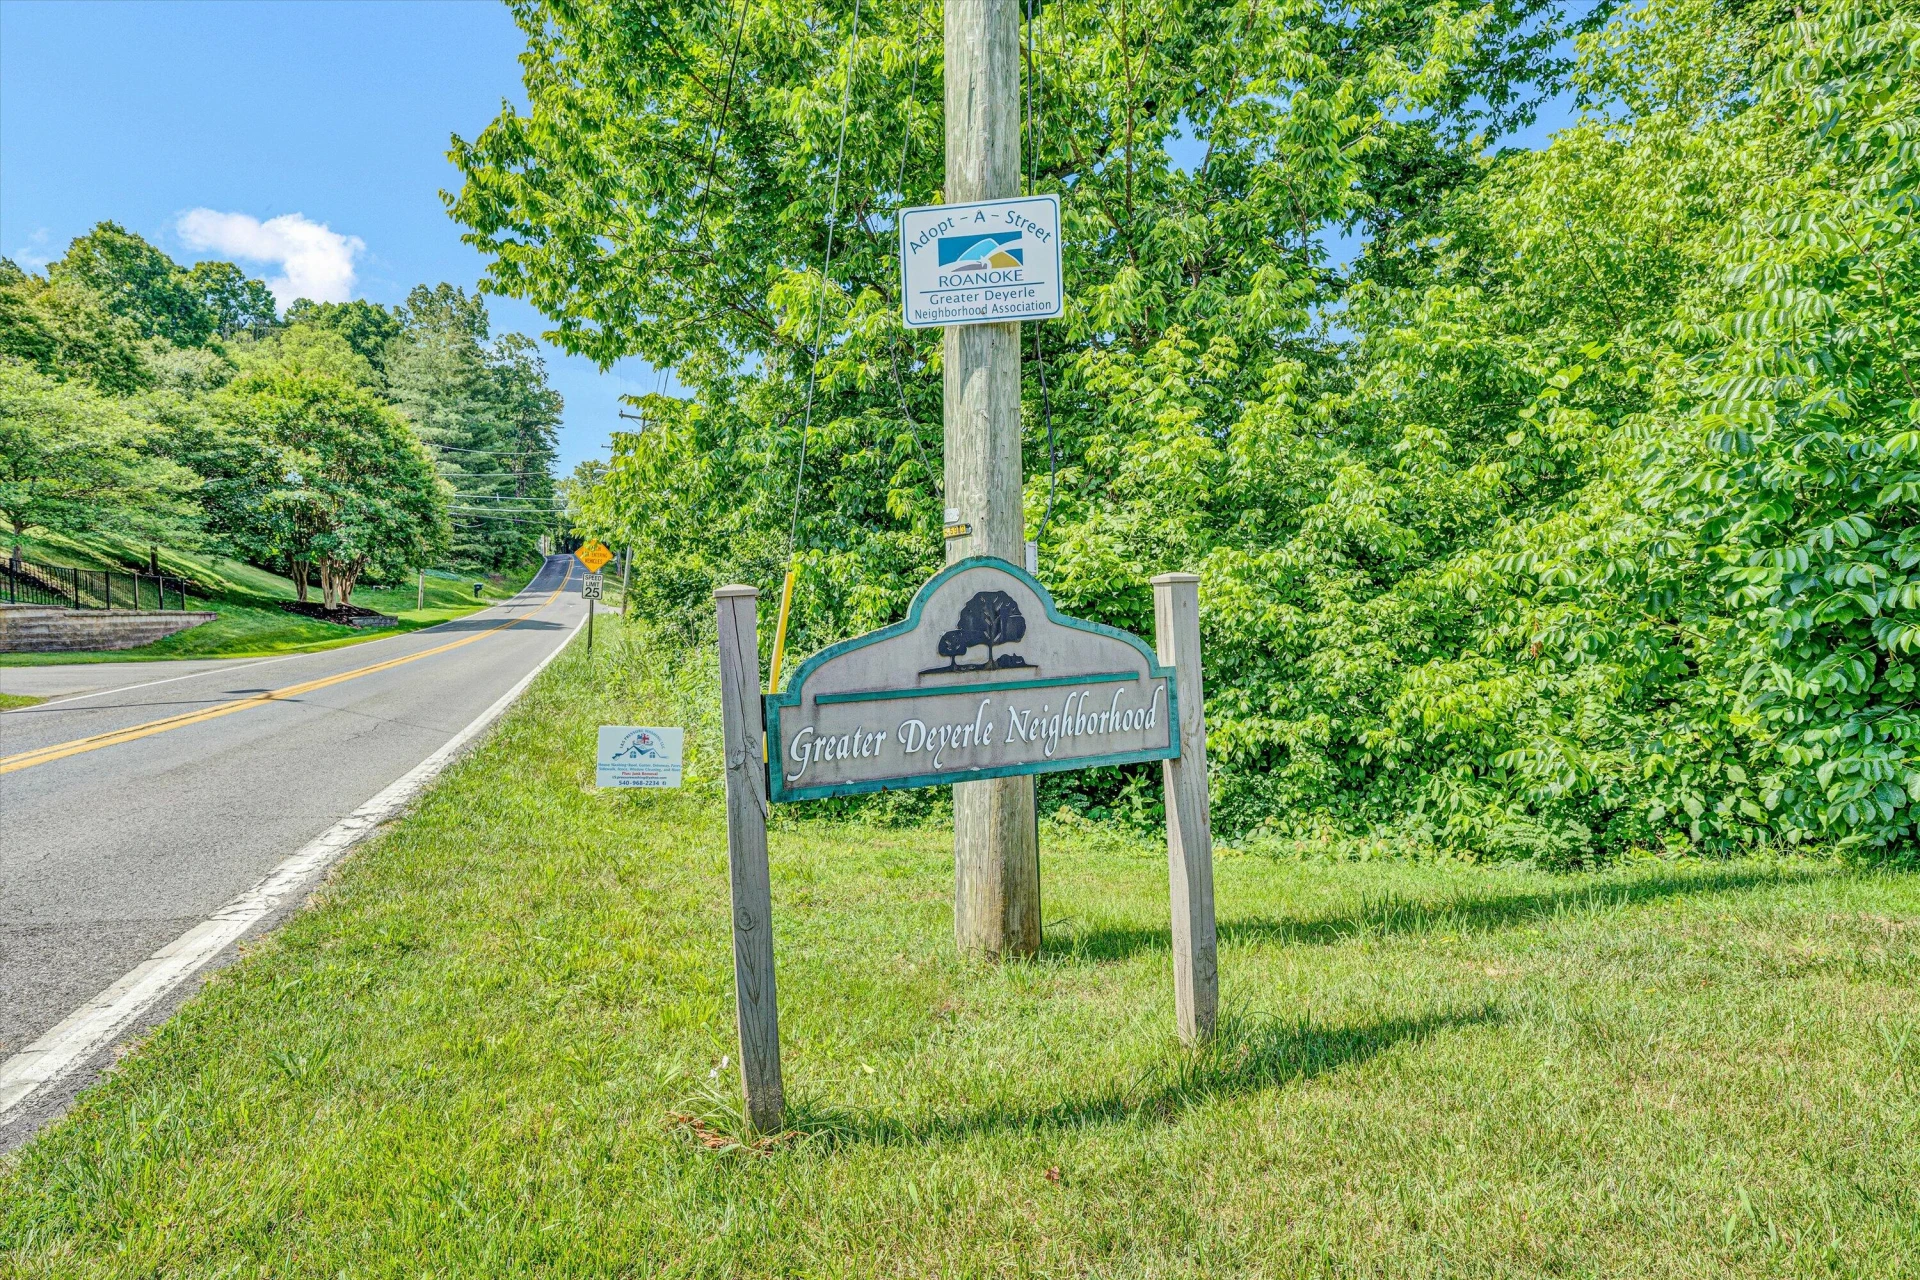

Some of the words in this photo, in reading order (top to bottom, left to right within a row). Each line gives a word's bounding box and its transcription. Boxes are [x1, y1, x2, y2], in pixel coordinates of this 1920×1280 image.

[909, 217, 955, 255] Adopt
[974, 210, 986, 223] A
[1005, 210, 1051, 243] Street
[939, 269, 1024, 287] ROANOKE
[930, 292, 979, 305] Greater
[984, 287, 1035, 301] Deyerle
[915, 304, 988, 321] Neighborhood
[992, 300, 1052, 314] Association
[585, 587, 600, 598] 25
[624, 729, 644, 740] PRESSURE
[786, 726, 888, 782] Greater
[898, 698, 994, 769] Deyerle
[1004, 685, 1164, 757] Neighborhood
